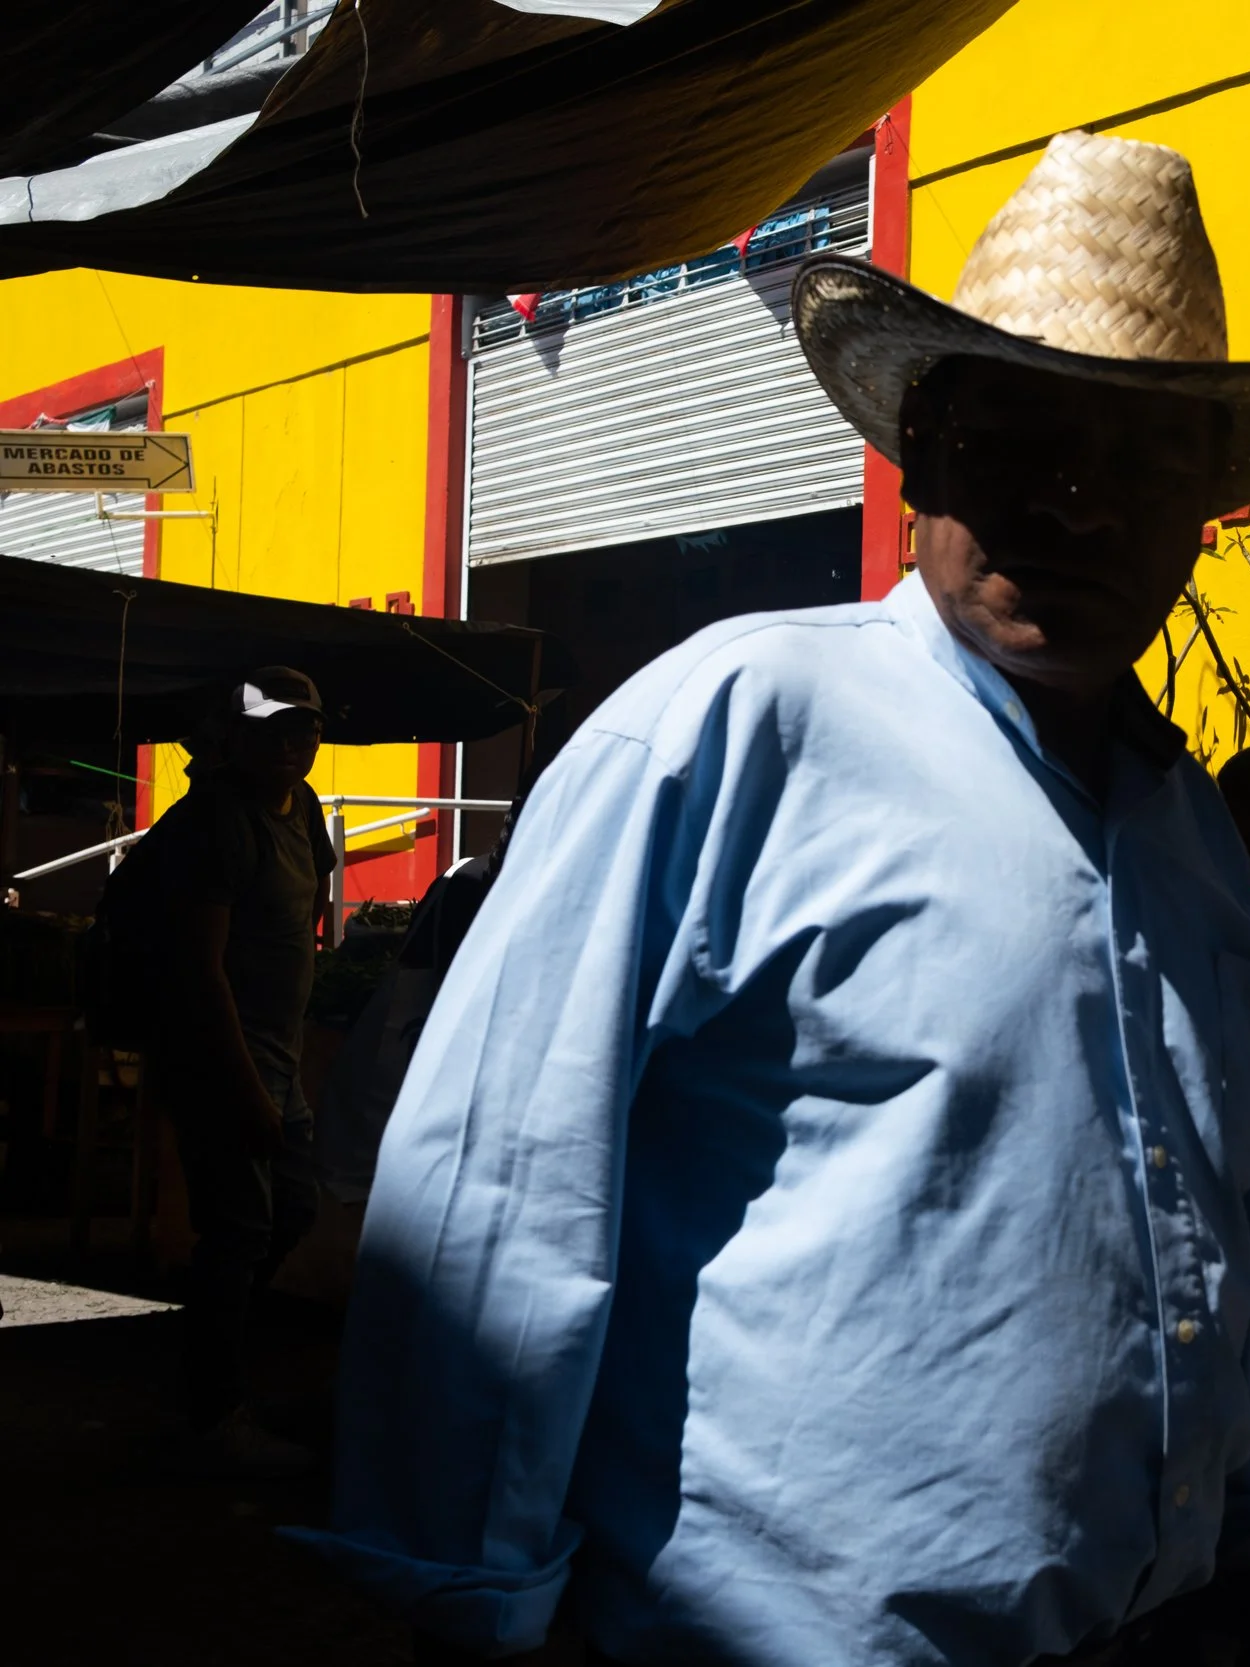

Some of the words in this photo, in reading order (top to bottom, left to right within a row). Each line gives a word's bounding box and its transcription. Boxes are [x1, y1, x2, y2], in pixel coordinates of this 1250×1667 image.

[3, 447, 112, 462] MERCADO
[120, 449, 145, 461] DE
[28, 462, 125, 476] ABASTOS
